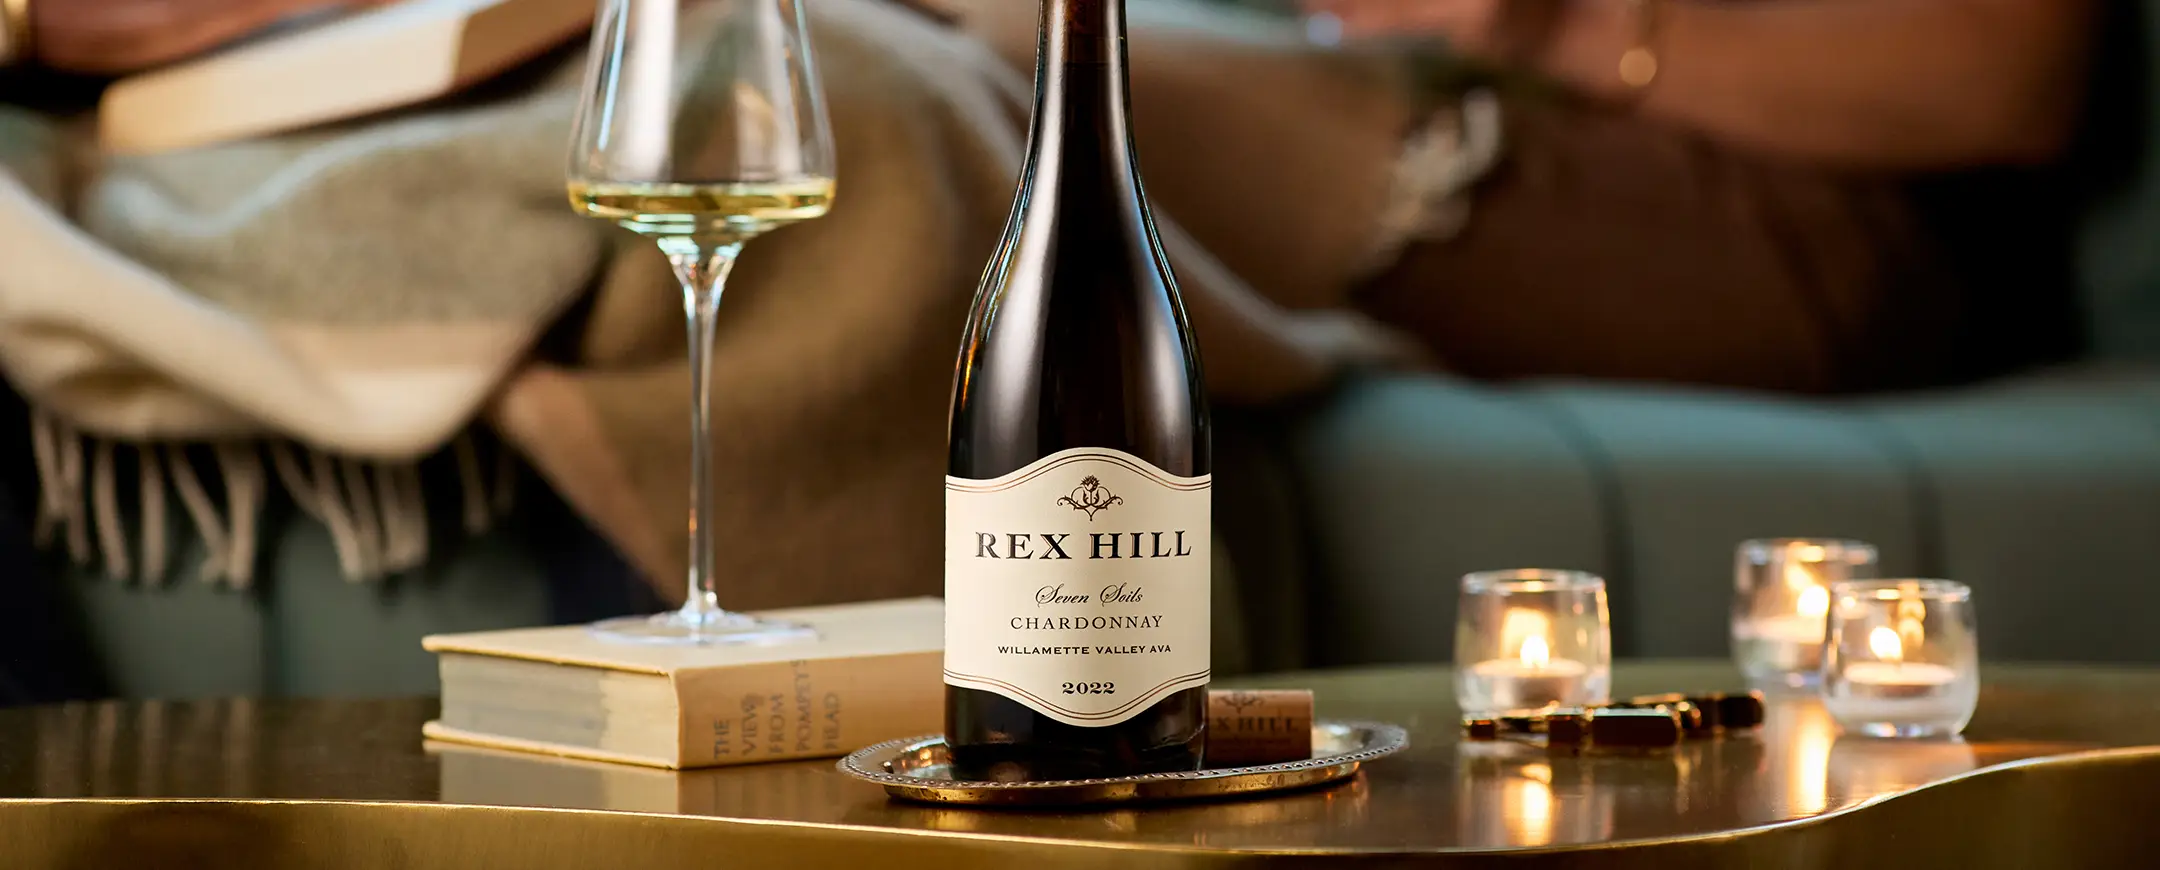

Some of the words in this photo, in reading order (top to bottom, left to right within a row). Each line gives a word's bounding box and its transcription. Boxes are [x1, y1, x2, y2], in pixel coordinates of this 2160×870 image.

[975, 531, 1072, 560] REX
[1089, 530, 1192, 560] HILL
[1035, 583, 1090, 608] Seven
[1099, 582, 1143, 608] Soils
[1010, 615, 1163, 630] CHARDONNAY
[998, 645, 1090, 655] WILLAMETTE
[1095, 645, 1146, 654] VALLEY
[1149, 645, 1171, 653] AVA
[1062, 682, 1115, 695] 2022
[768, 693, 786, 755] FROM
[713, 718, 730, 760] THE
